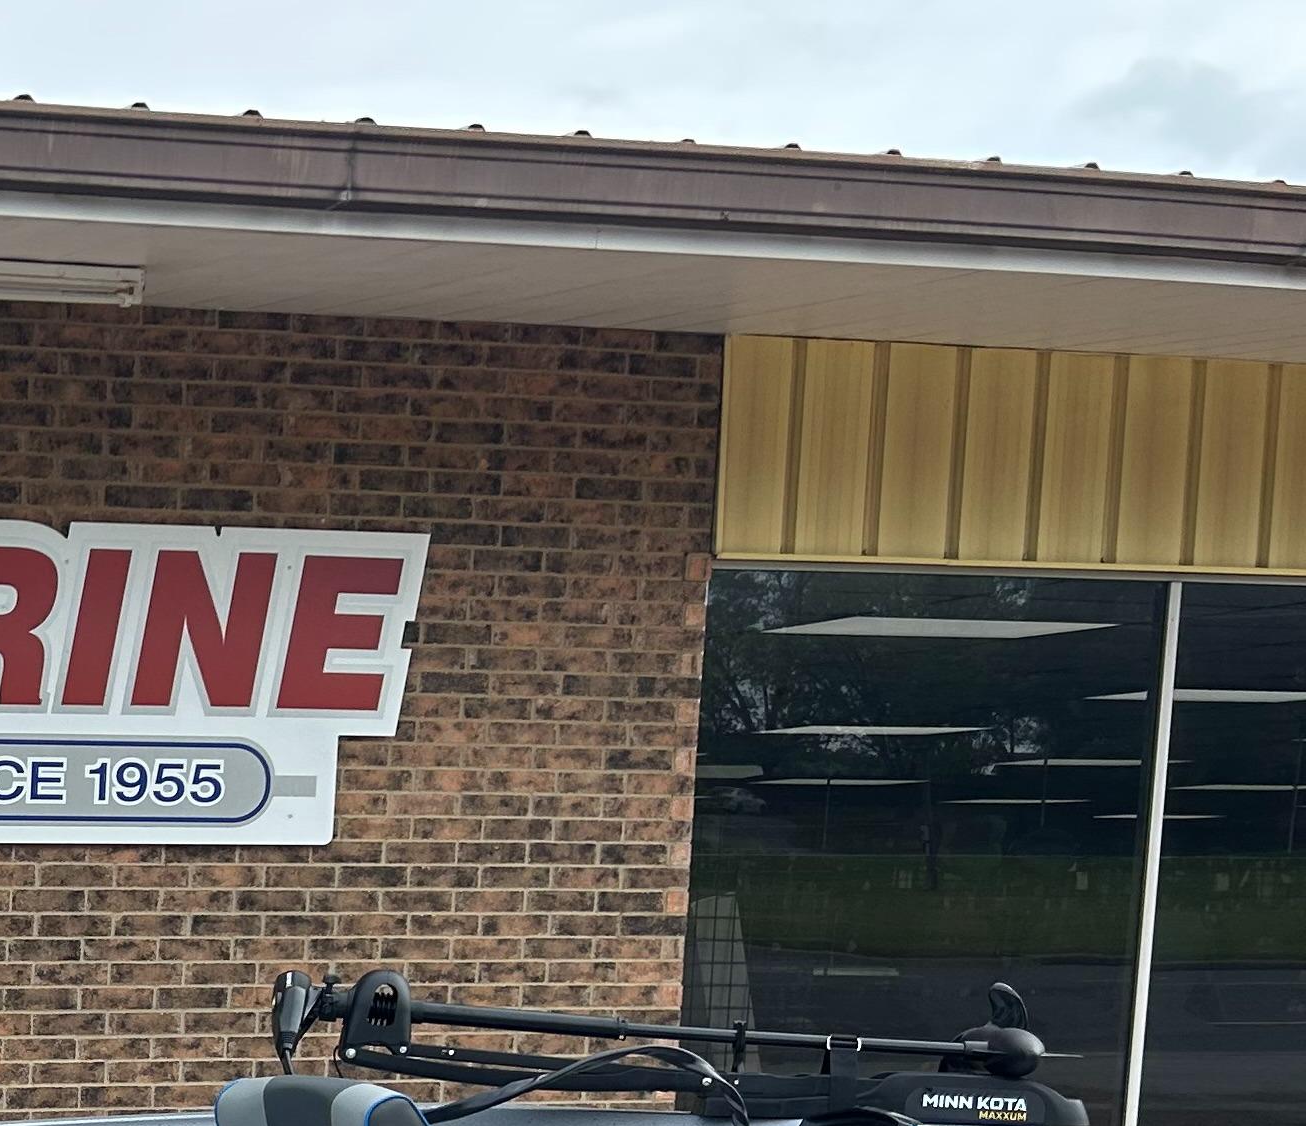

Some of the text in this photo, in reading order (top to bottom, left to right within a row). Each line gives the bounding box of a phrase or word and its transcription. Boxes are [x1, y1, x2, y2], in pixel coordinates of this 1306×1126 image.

[86, 757, 225, 805] 1955
[922, 1093, 1027, 1111] MINN KOTA
[978, 1110, 1027, 1121] MAXXUM
